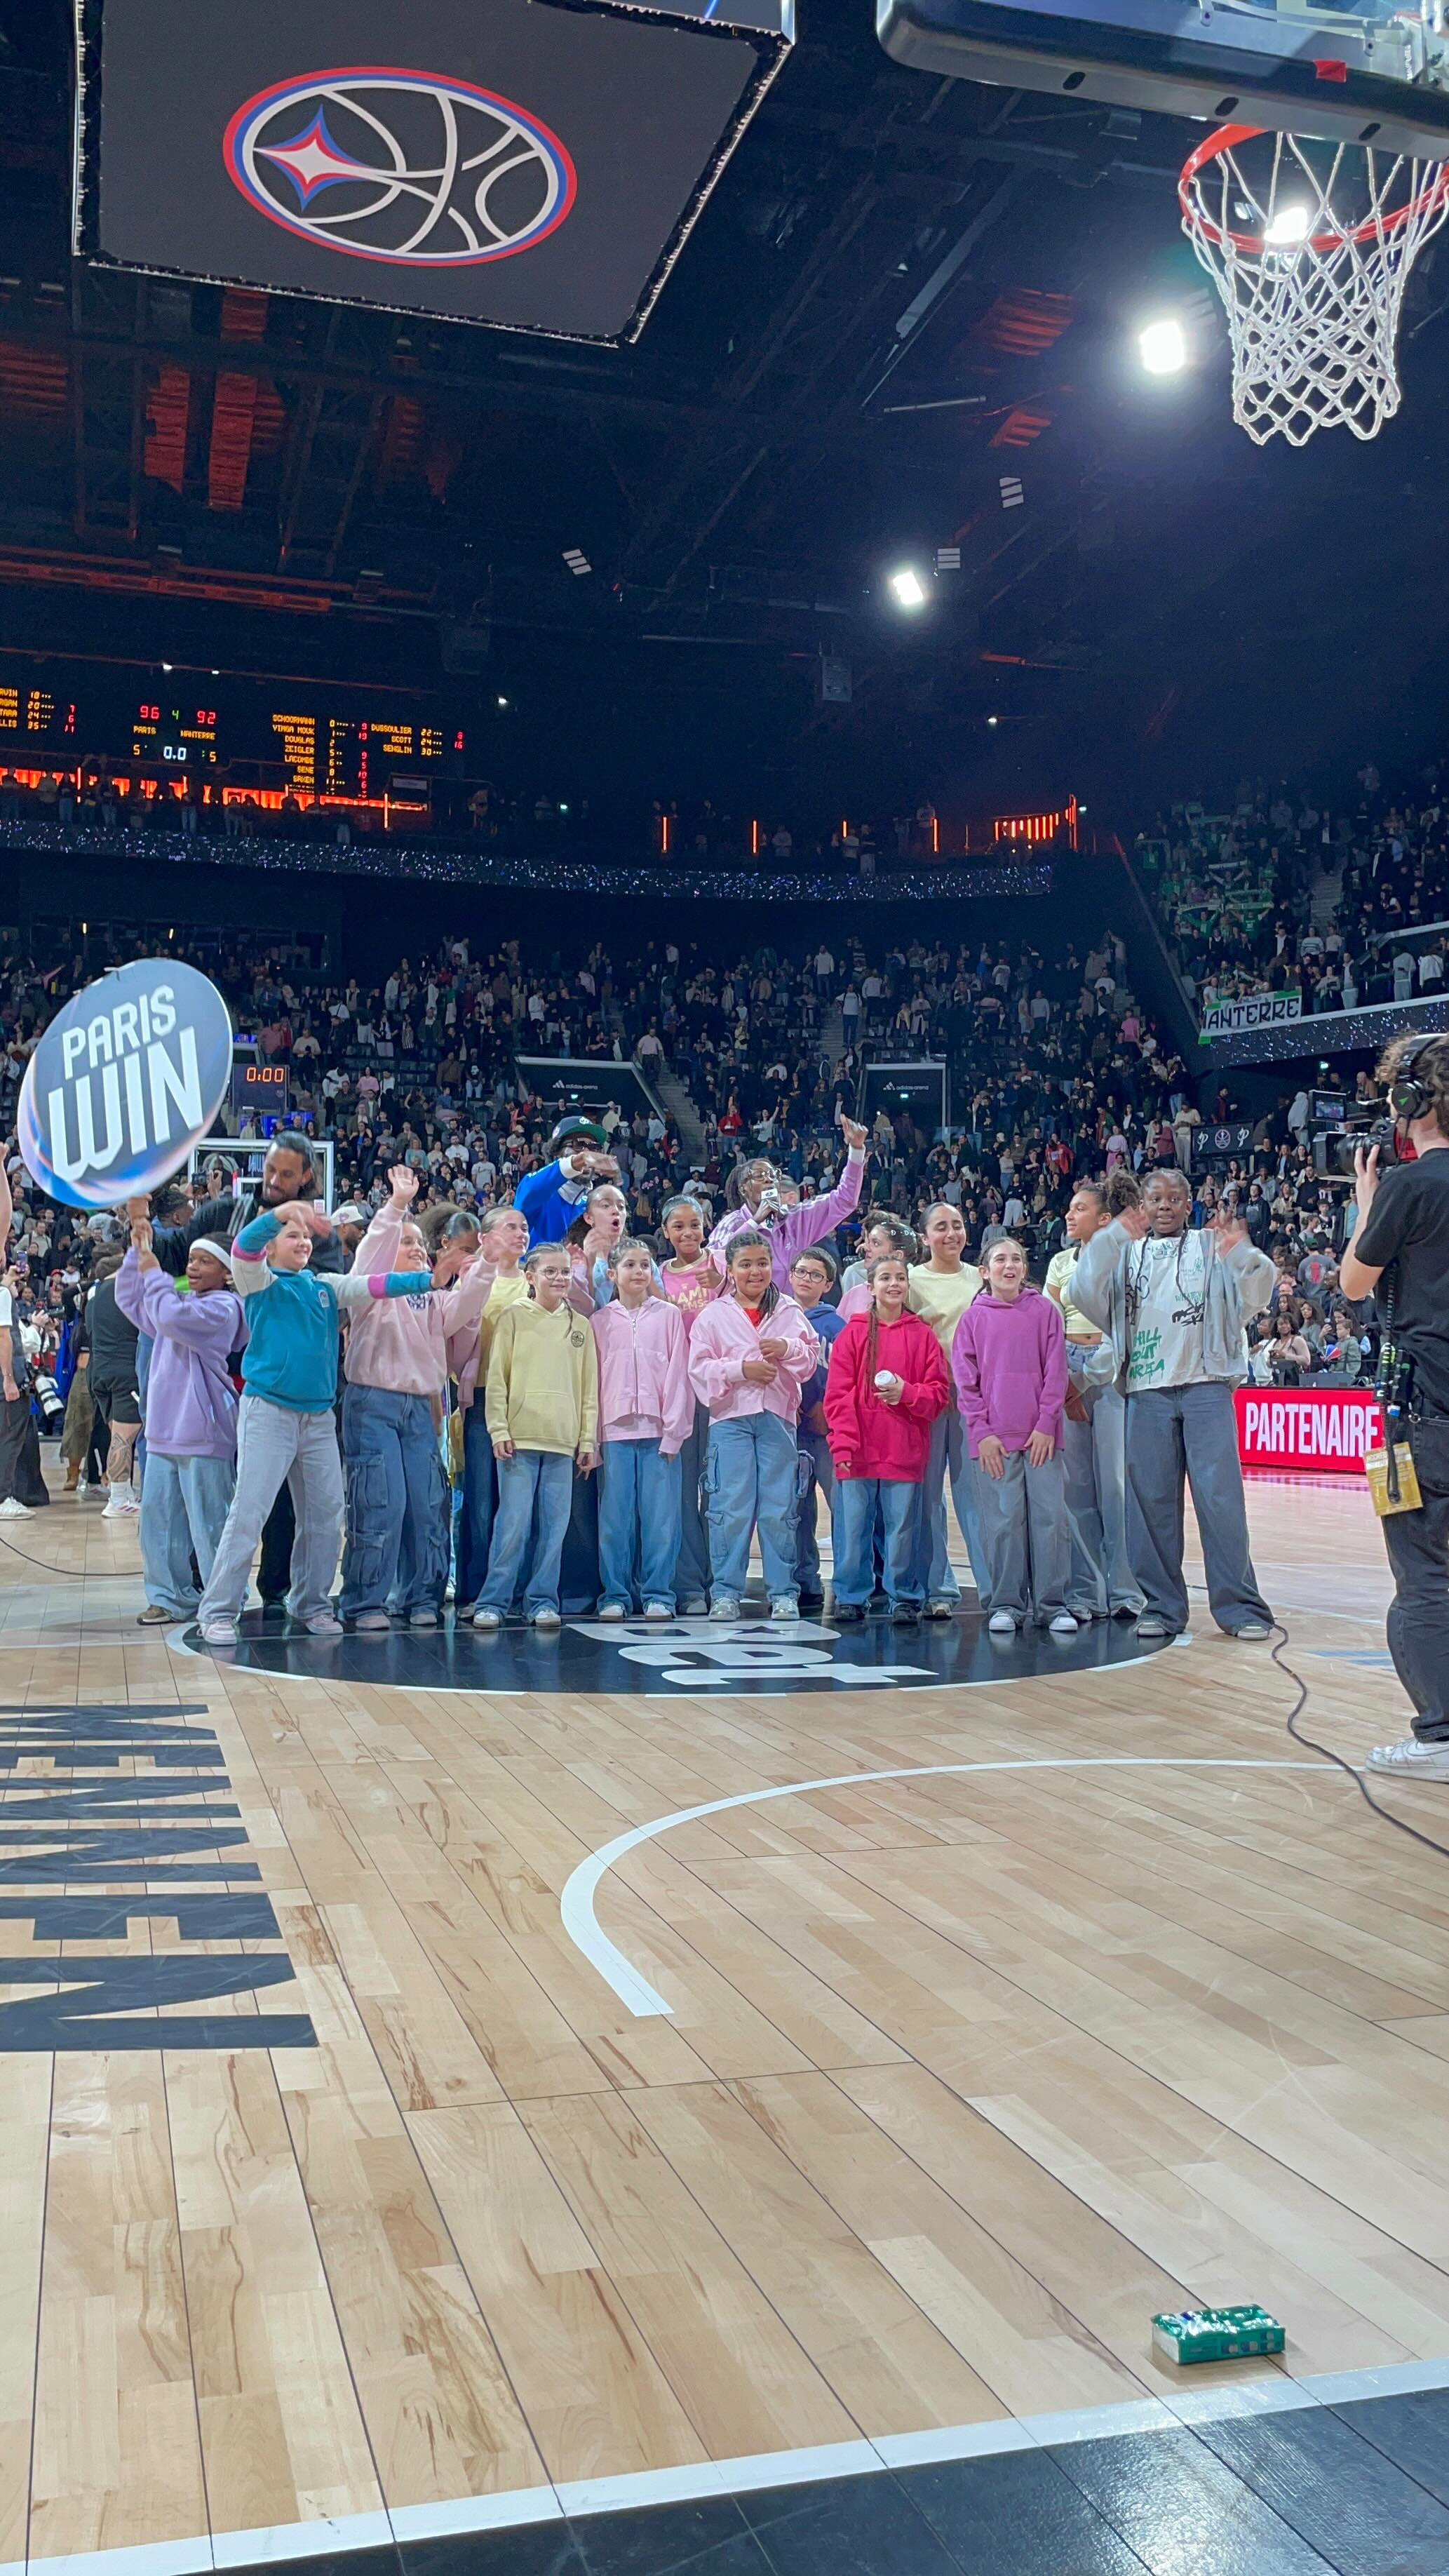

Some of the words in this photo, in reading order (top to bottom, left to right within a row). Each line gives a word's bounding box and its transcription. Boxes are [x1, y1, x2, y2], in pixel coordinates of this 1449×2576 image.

[140, 705, 160, 720] 96
[172, 709, 179, 720] 4
[197, 710, 216, 725] 92
[133, 725, 156, 734] PARIS
[180, 730, 216, 741] NANTERRE
[421, 728, 432, 737] 22
[391, 735, 412, 744] SCOTT
[133, 744, 140, 756] 5
[163, 746, 187, 760] 0.0
[209, 751, 217, 763] 5
[284, 745, 315, 755] ZEIGLER
[284, 755, 315, 765] LACOMBE
[62, 985, 177, 1080] PARIS
[247, 1066, 284, 1082] 0:00
[48, 1026, 204, 1183] WIN
[1131, 1342, 1157, 1362] OUT
[1129, 1358, 1165, 1381] AREA
[1244, 1401, 1380, 1458] PARTENAIRE
